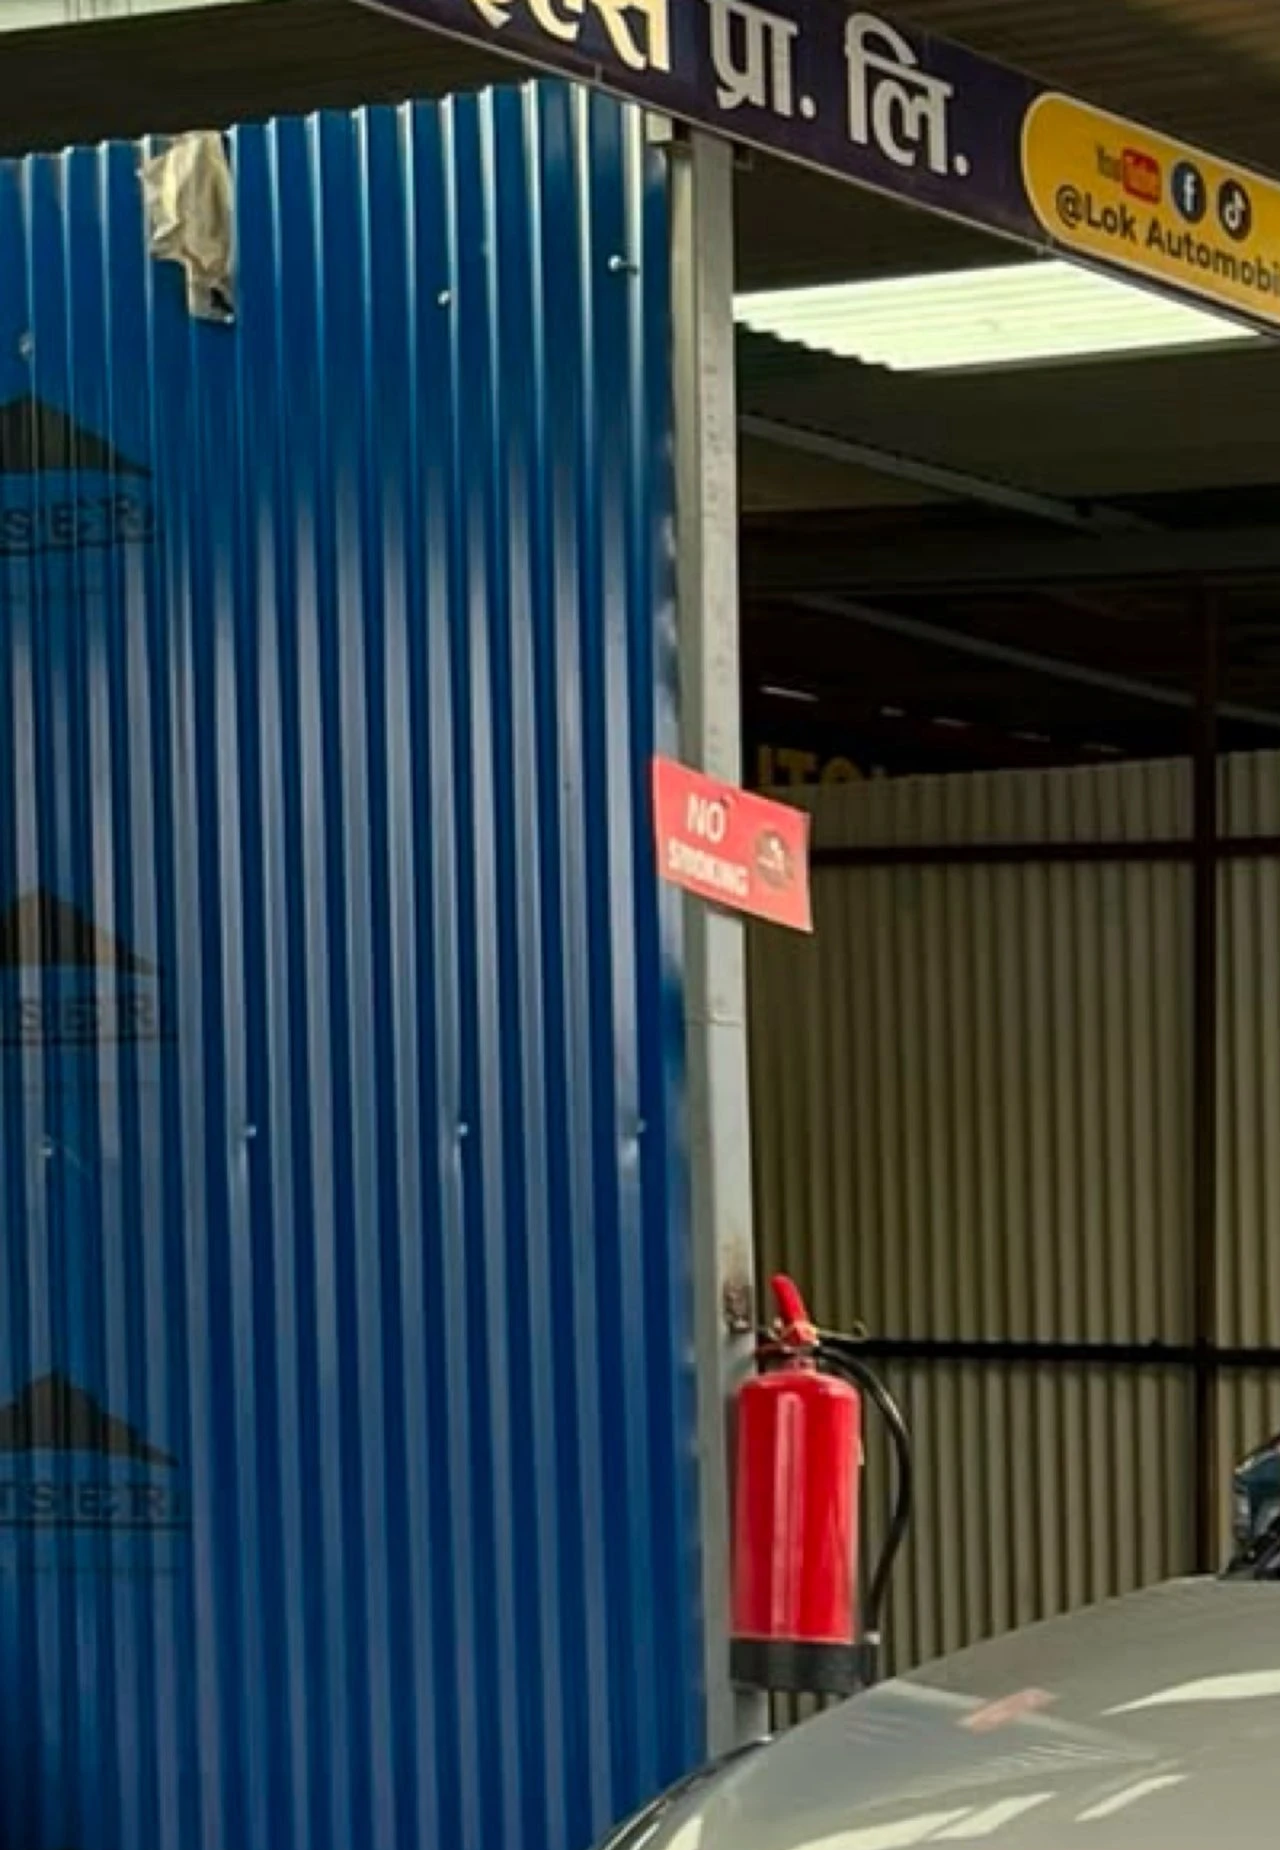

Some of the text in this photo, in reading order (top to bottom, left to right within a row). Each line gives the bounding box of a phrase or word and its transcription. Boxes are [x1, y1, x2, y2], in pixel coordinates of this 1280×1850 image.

[843, 12, 971, 176] लि.
[1056, 184, 1137, 243] @Lok
[686, 791, 726, 844] NO
